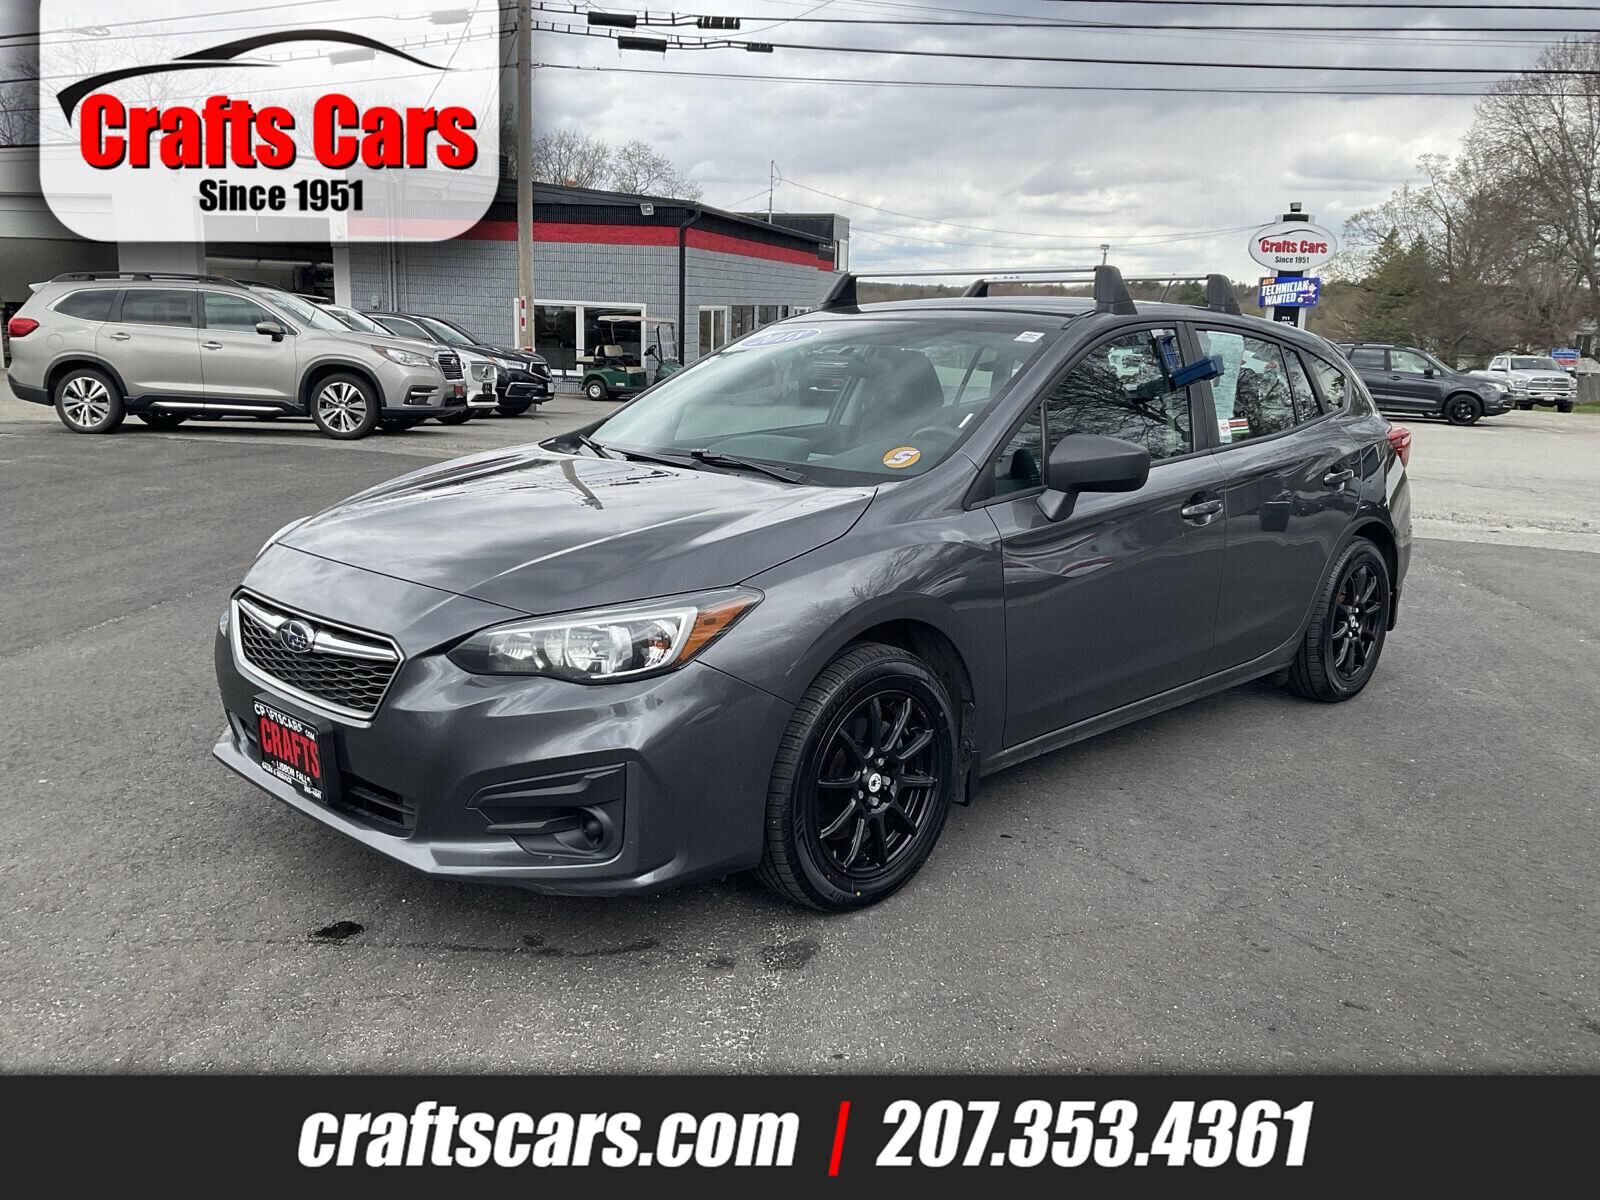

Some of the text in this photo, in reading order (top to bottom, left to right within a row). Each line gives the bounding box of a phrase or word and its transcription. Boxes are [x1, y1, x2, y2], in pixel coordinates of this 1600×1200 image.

[1261, 240, 1328, 254] Crafts Cars
[1275, 256, 1310, 264] Since 1951
[1262, 280, 1310, 296] TECHNICIAN
[1265, 292, 1297, 306] WANTED
[260, 717, 320, 778] CRAFTS
